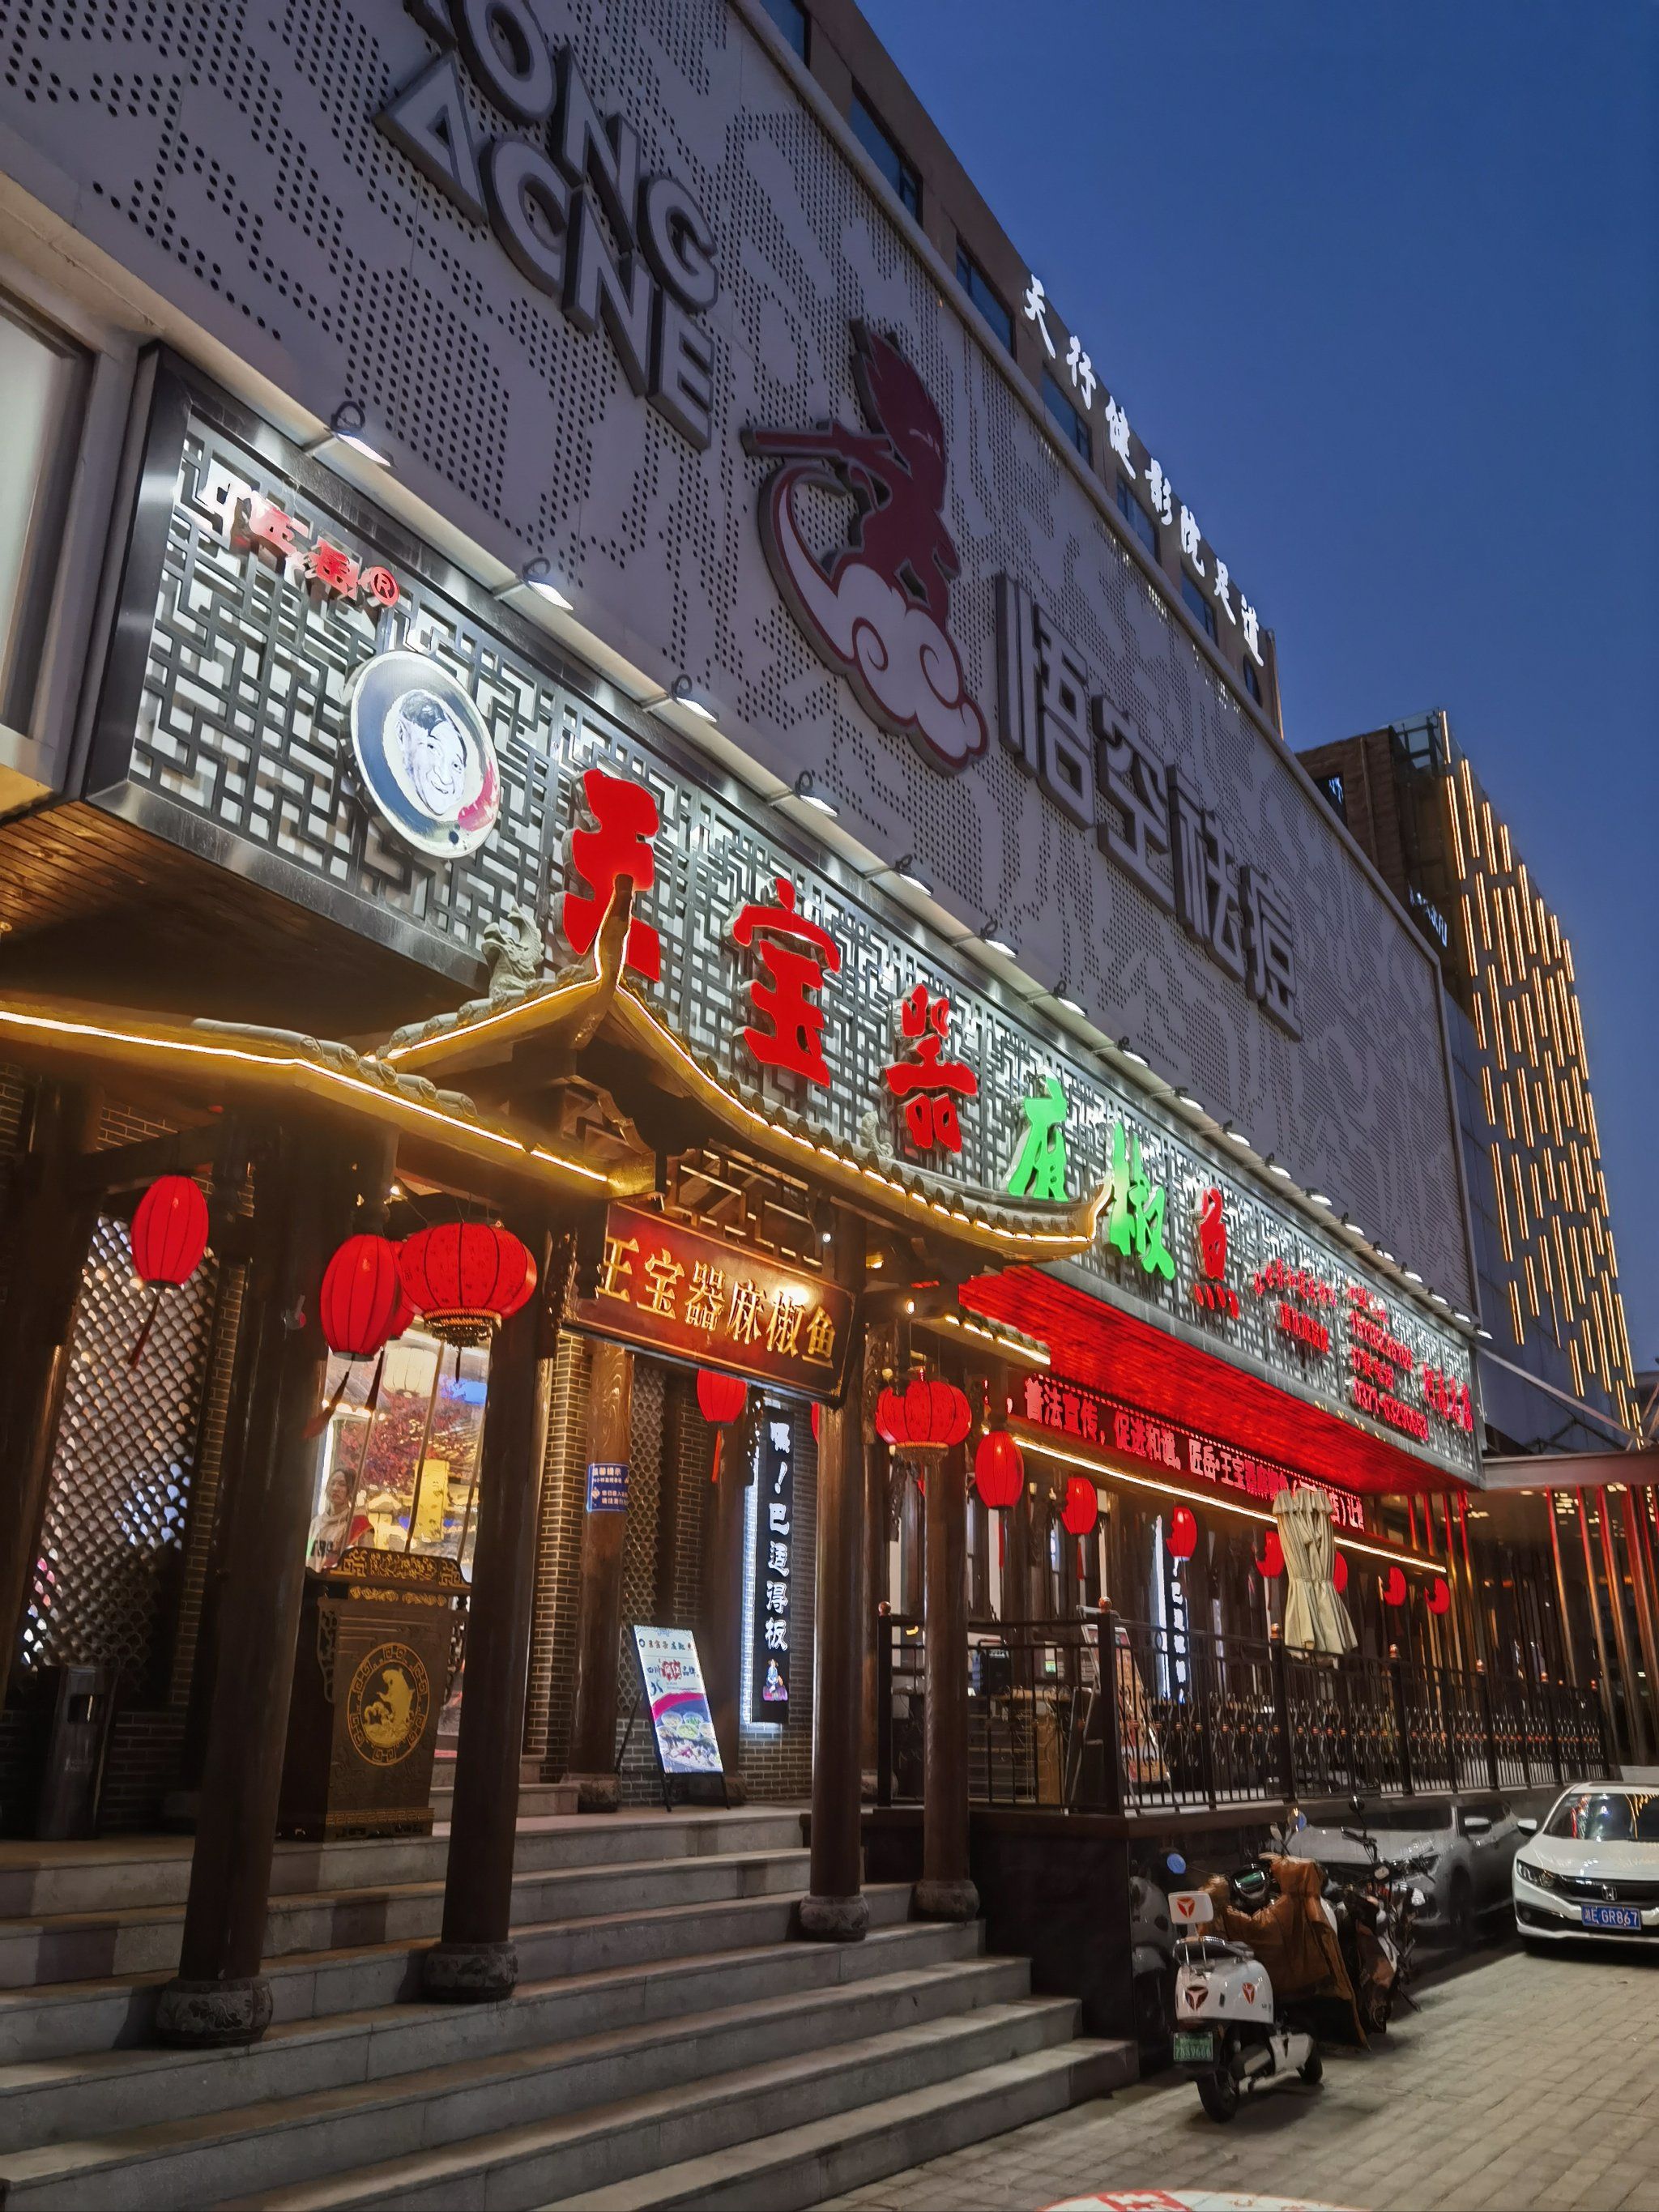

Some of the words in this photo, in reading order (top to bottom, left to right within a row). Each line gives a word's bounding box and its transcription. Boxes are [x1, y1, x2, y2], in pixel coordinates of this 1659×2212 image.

[374, 50, 716, 452] ACNE
[417, 0, 719, 314] ONG
[996, 570, 1303, 1042] 悟空祛痘
[596, 1235, 836, 1370] 王宝器麻椒鱼
